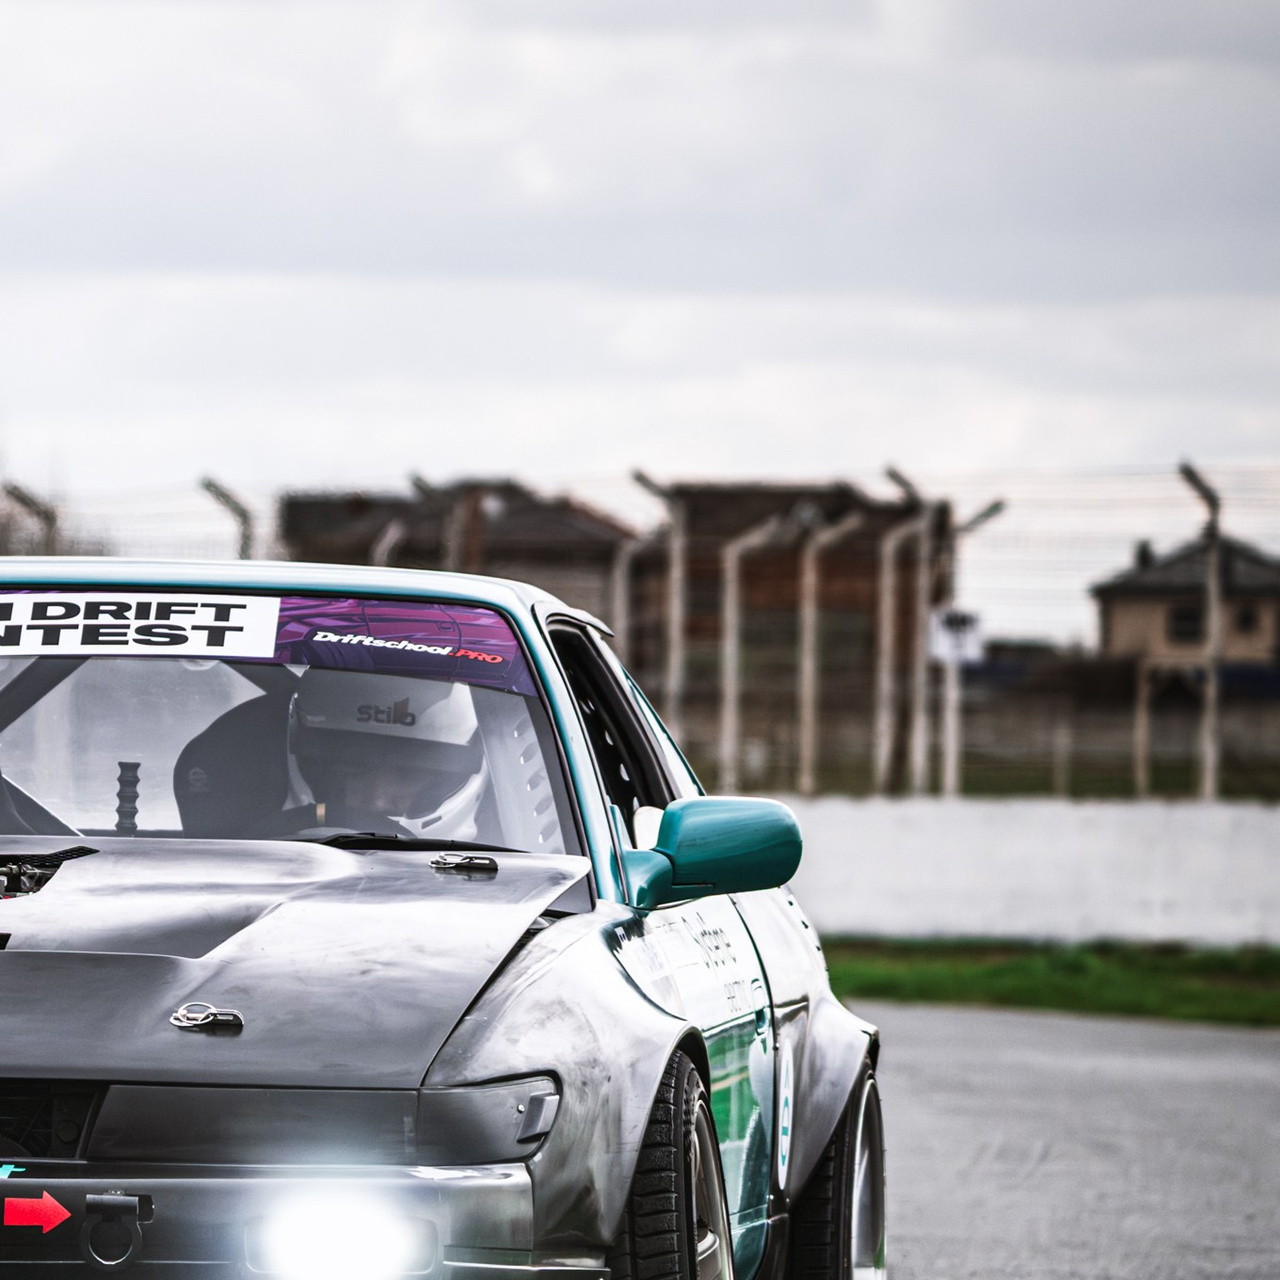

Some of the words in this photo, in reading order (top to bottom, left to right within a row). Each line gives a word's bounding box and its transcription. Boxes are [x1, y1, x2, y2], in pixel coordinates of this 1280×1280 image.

[30, 601, 247, 622] DRIFT
[313, 631, 504, 663] Driftschool.PRO
[356, 697, 416, 726] Stilo
